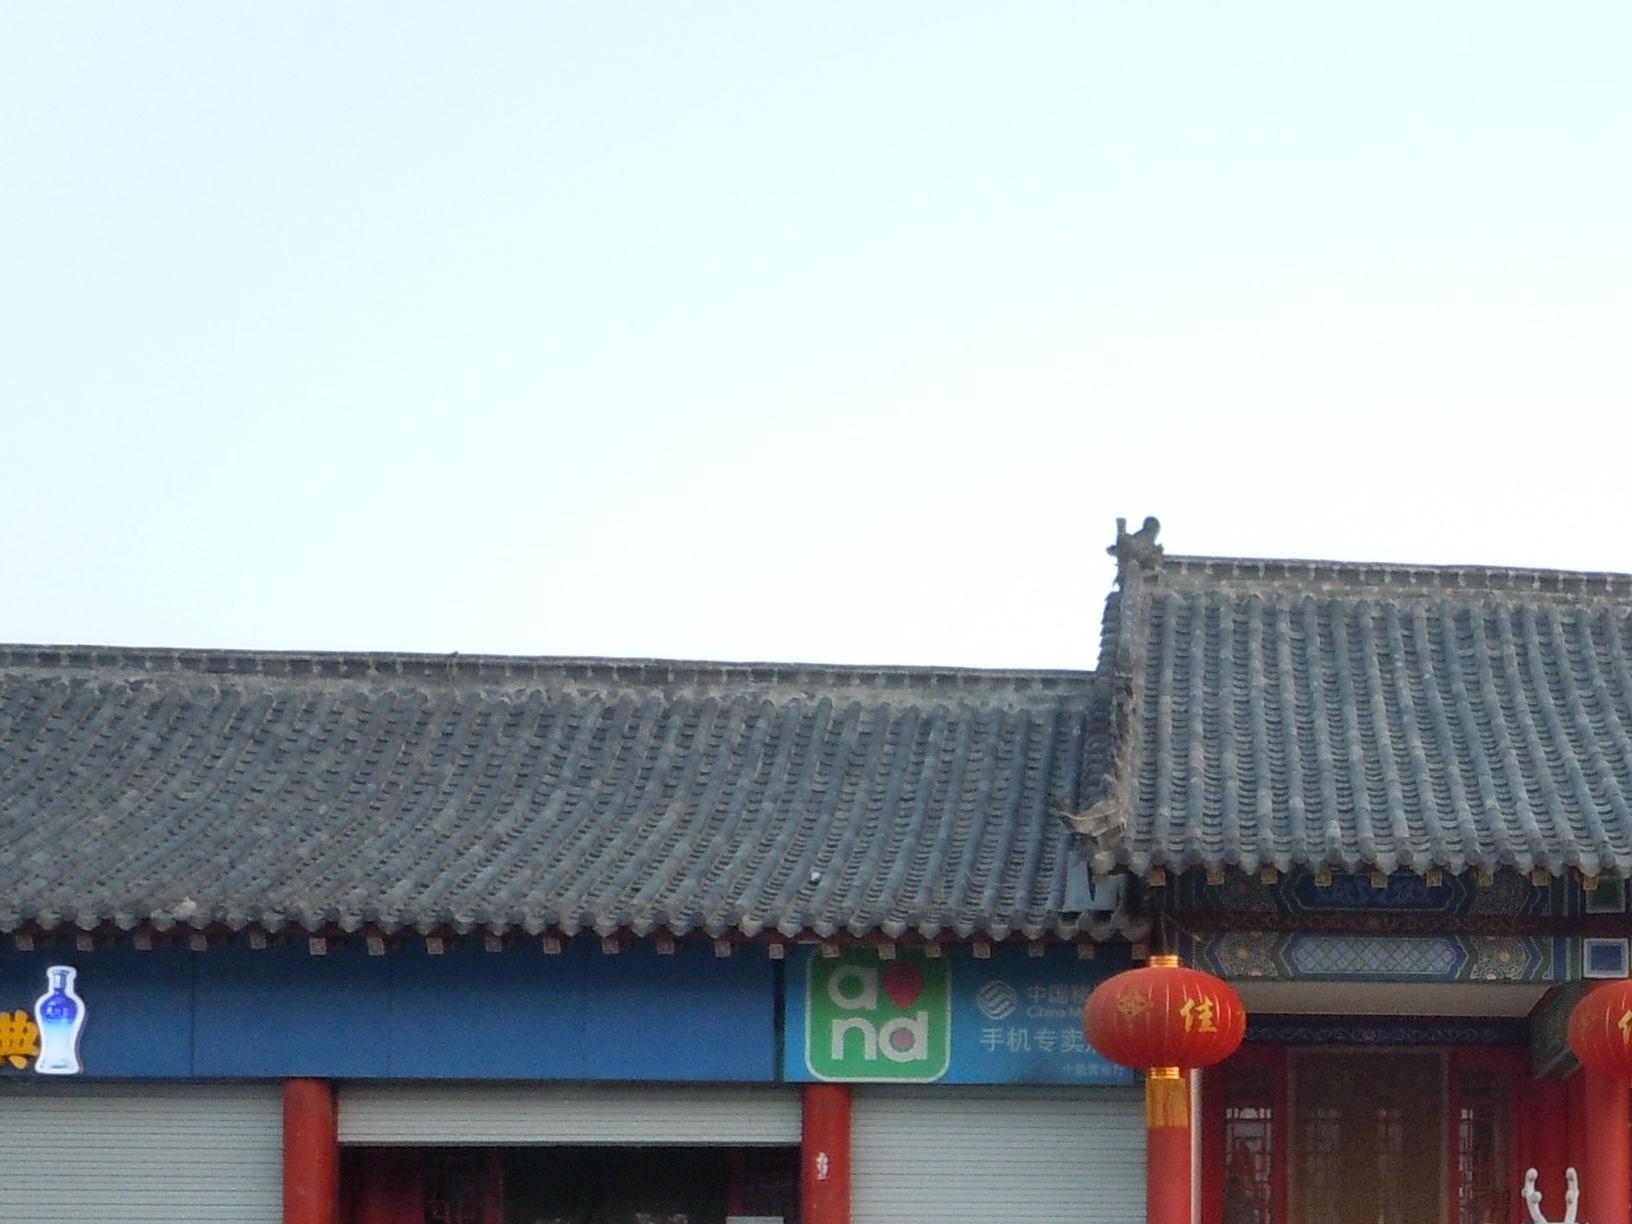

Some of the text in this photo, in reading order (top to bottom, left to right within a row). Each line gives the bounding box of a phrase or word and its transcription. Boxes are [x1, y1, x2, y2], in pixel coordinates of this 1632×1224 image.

[1179, 996, 1218, 1033] 佳
[980, 1027, 1097, 1054] 手机专卖
